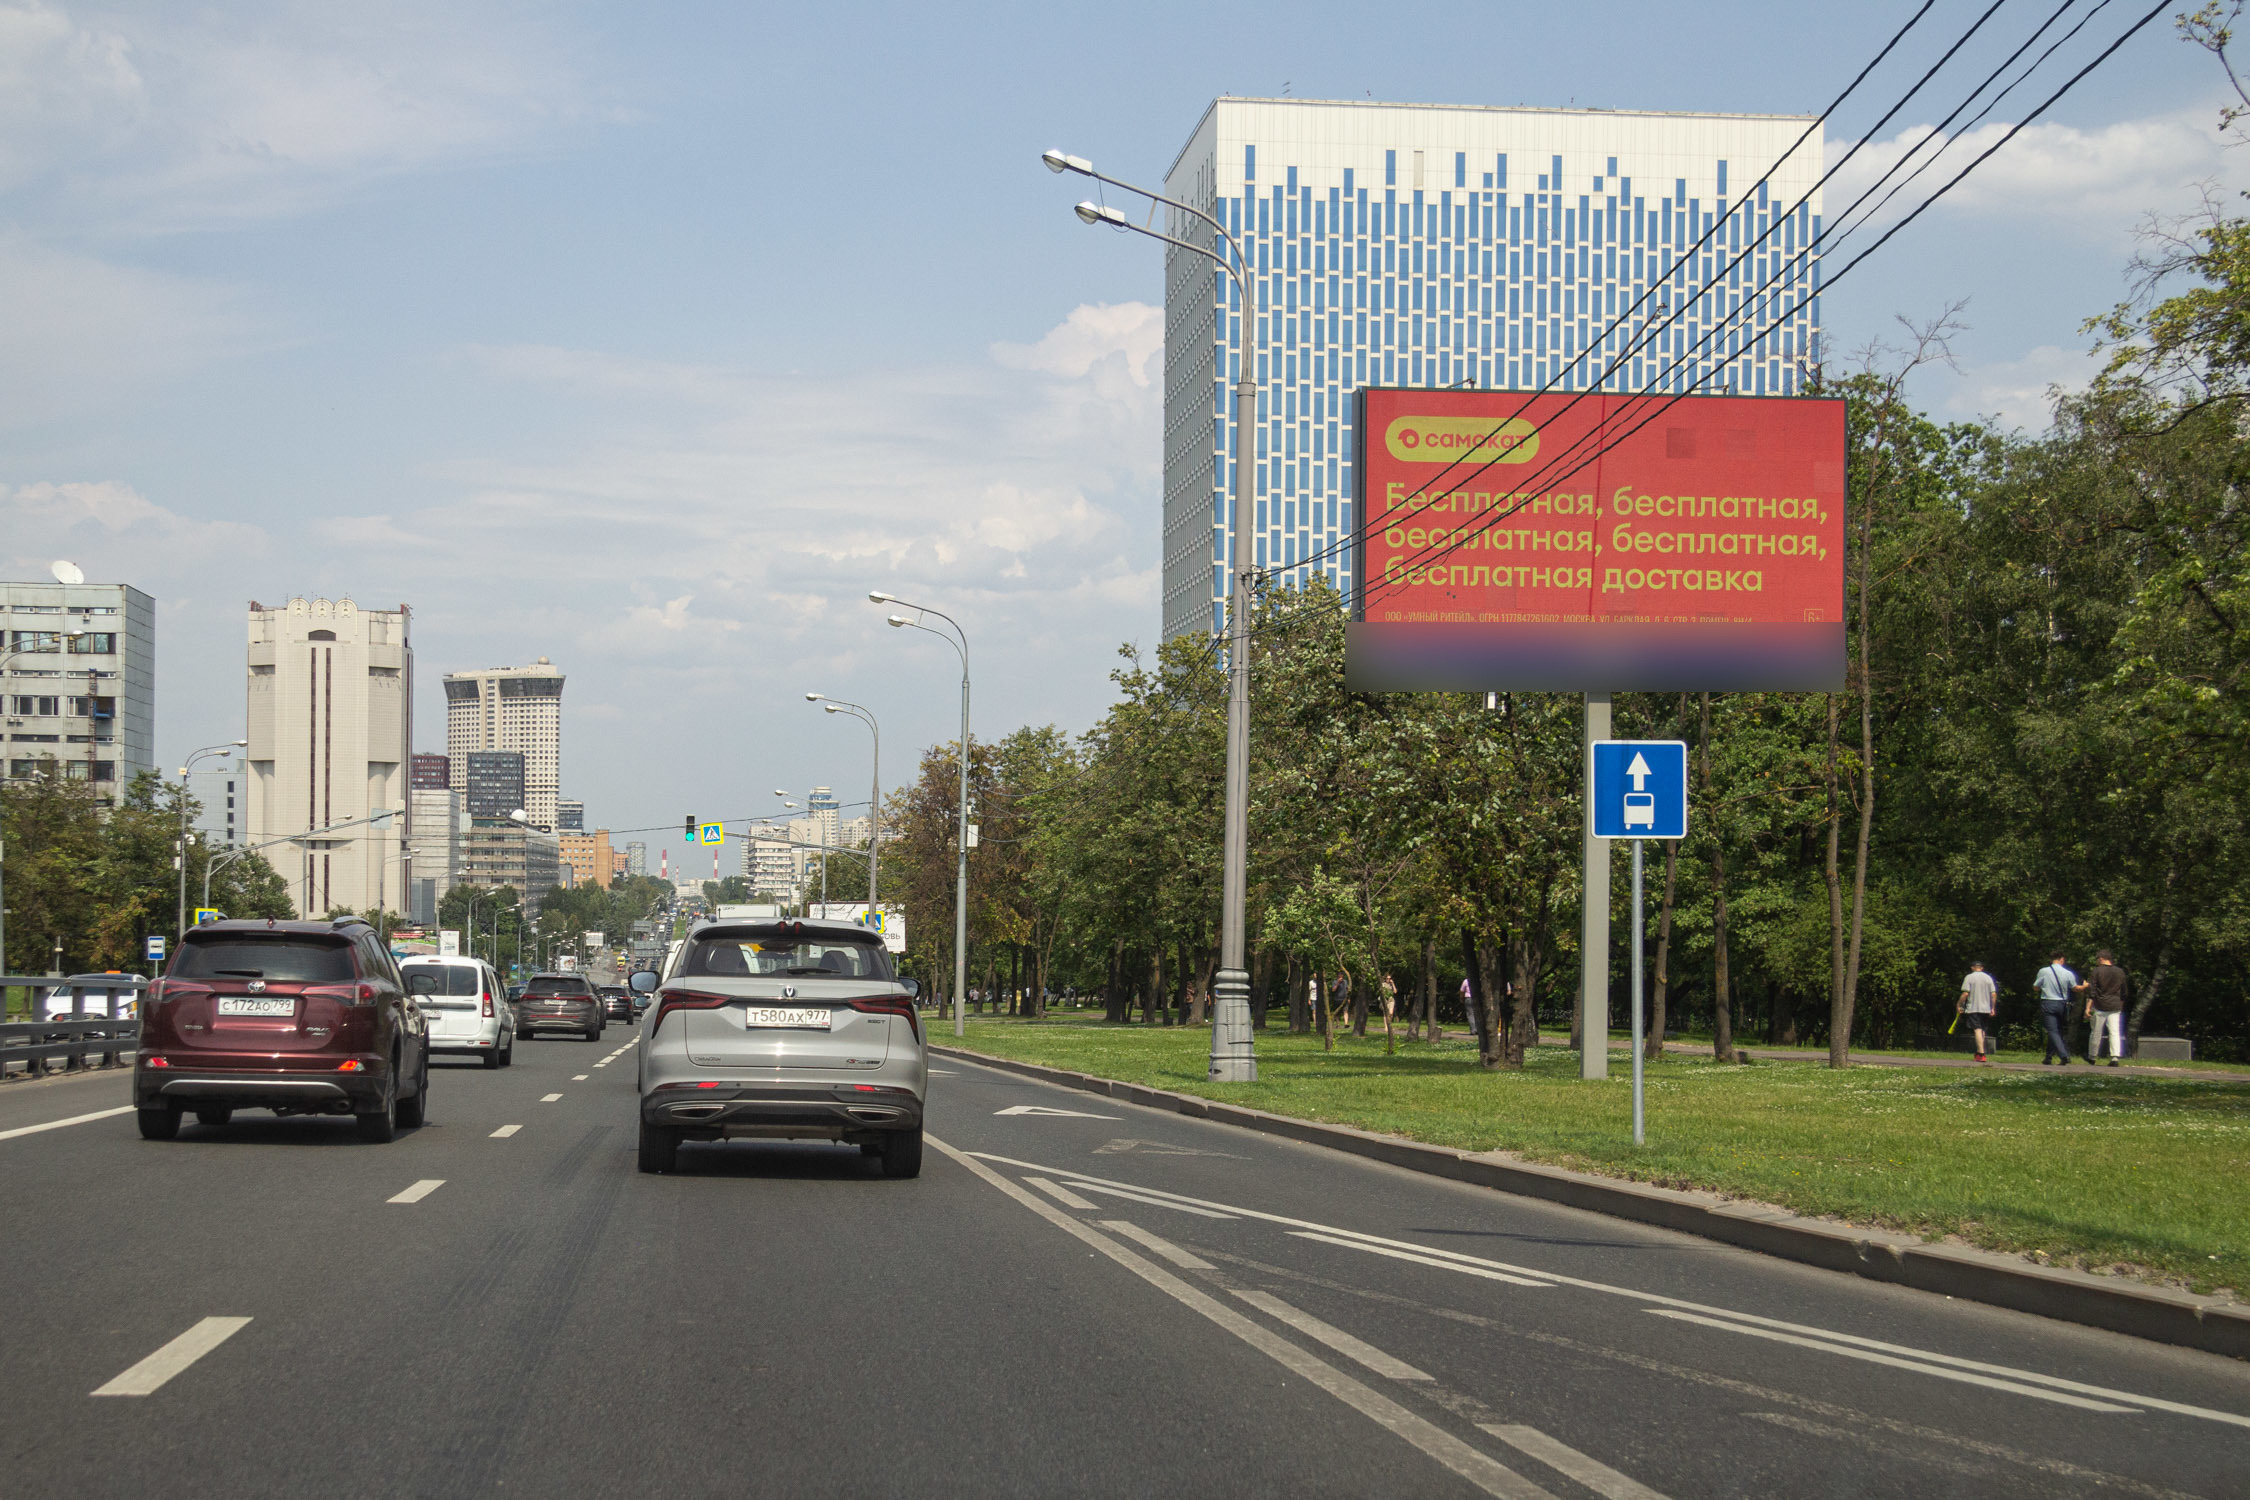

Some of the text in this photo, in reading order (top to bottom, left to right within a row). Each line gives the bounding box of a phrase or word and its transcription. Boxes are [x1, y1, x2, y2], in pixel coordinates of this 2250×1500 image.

[1425, 432, 1529, 449] самокат
[1386, 482, 1827, 524] Бесплатная, бесплатная,
[1384, 519, 1827, 561] бесплатная, бесплатная,
[1384, 555, 1762, 593] бесплатная доставка
[1384, 611, 1402, 622] ООО
[1479, 612, 1499, 622] ОГРН
[1808, 611, 1821, 622] 6+
[751, 1009, 804, 1023] Т580АХ
